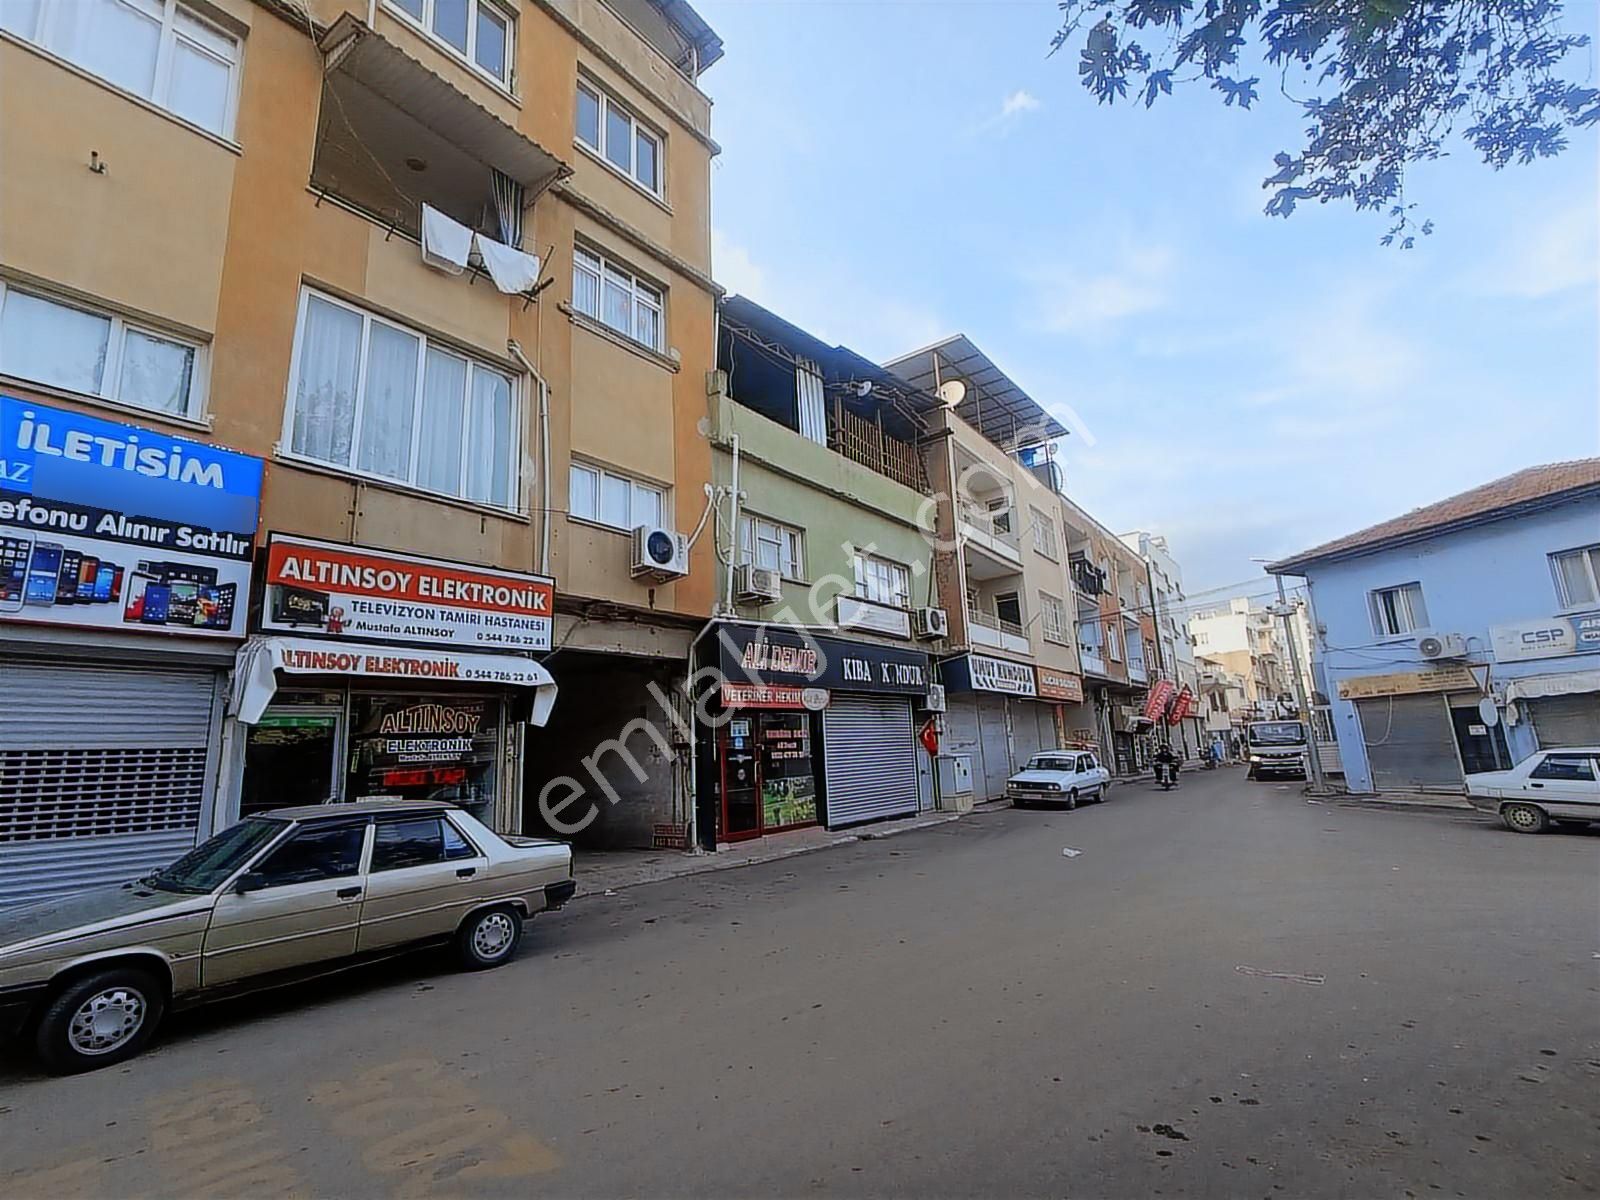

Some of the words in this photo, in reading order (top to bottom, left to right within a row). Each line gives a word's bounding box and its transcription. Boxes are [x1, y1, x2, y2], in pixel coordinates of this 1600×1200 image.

[96, 514, 170, 543] Alınır
[176, 528, 249, 556] Satılır
[279, 556, 412, 593] ALTINSOY
[418, 576, 547, 611] ELEKTRONİK
[351, 600, 435, 620] TELEVİZYON
[355, 620, 401, 634] Mustafa
[403, 625, 455, 638] ALTINSOY
[476, 632, 483, 641] 0
[486, 633, 502, 642] 544
[523, 636, 533, 645] 22
[1521, 628, 1564, 644] CSP
[365, 654, 460, 678] ELEKTRONİK
[465, 669, 472, 679] 0
[474, 669, 491, 680] 544
[513, 673, 524, 682] 22
[527, 672, 538, 682] 61
[379, 704, 481, 734] ALTINSOY
